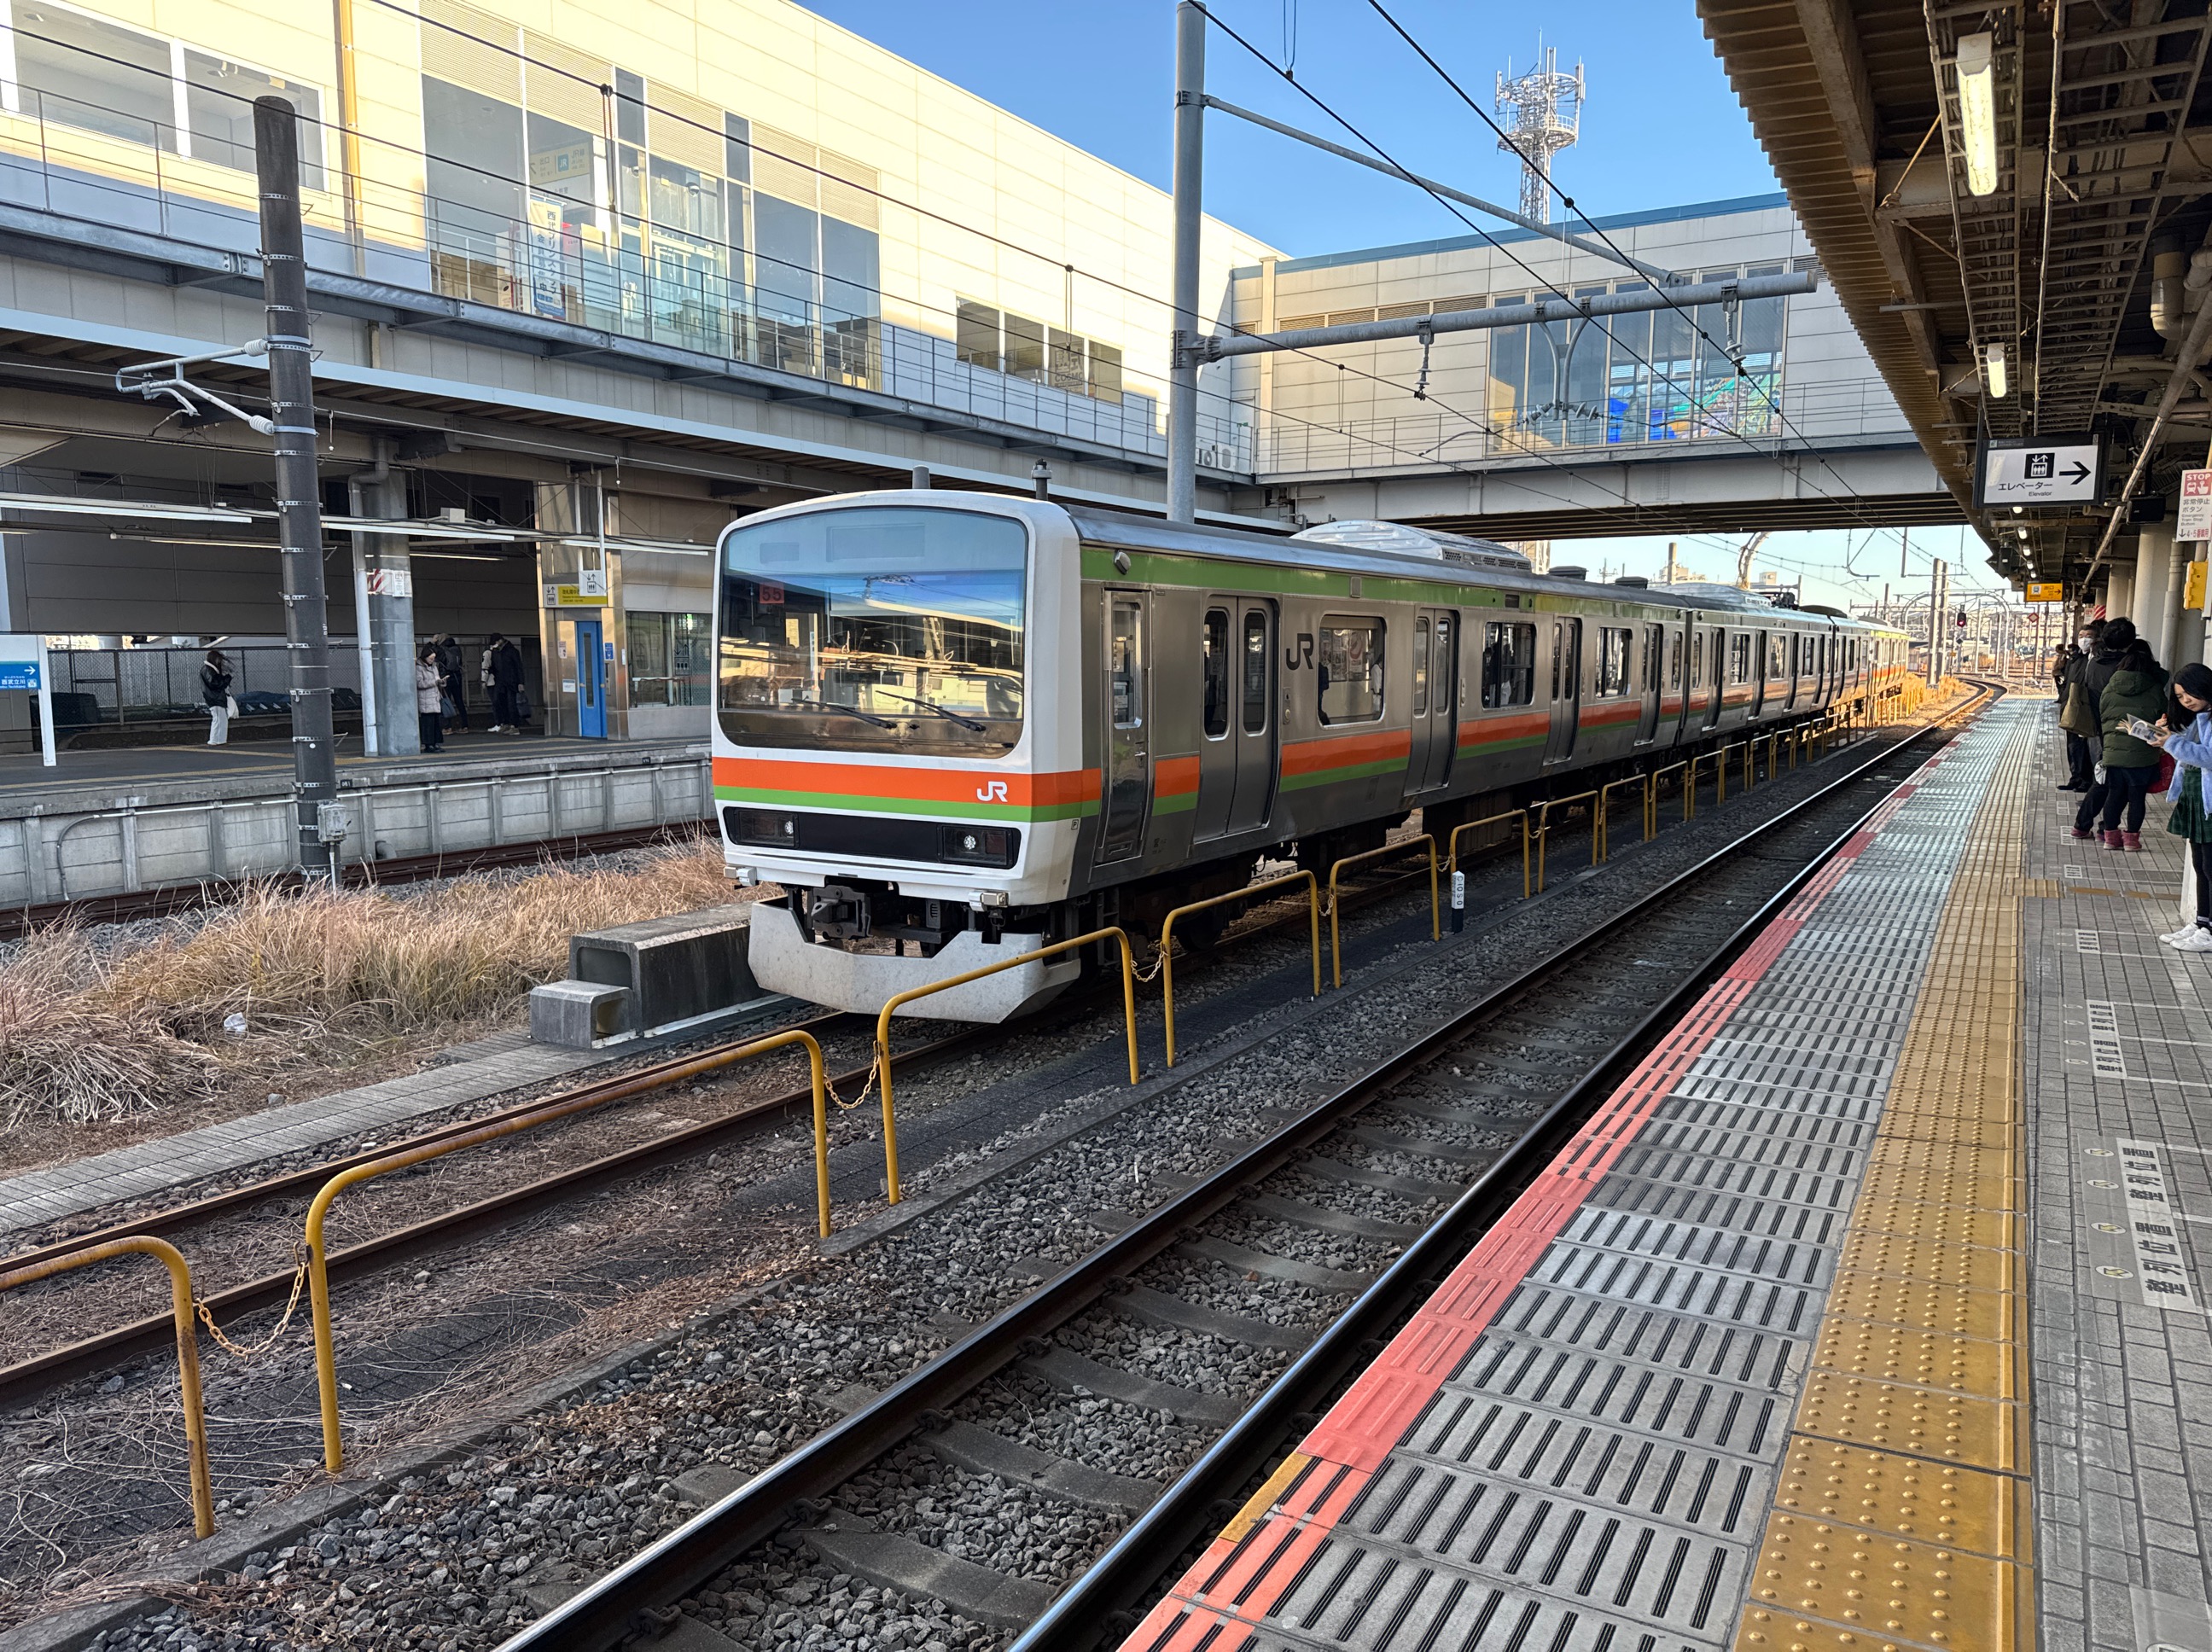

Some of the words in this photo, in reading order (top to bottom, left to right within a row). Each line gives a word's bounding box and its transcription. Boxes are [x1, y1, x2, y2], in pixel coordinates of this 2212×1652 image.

[560, 159, 568, 168] JR
[2186, 473, 2211, 481] STOP
[1998, 481, 2053, 491] エレベーター
[2183, 497, 2210, 506] 非常停止
[762, 585, 782, 602] 55
[1285, 633, 1314, 671] JR
[976, 781, 1008, 802] JR
[2122, 1147, 2165, 1203] 整列位置
[2135, 1221, 2187, 1297] 整列位置
